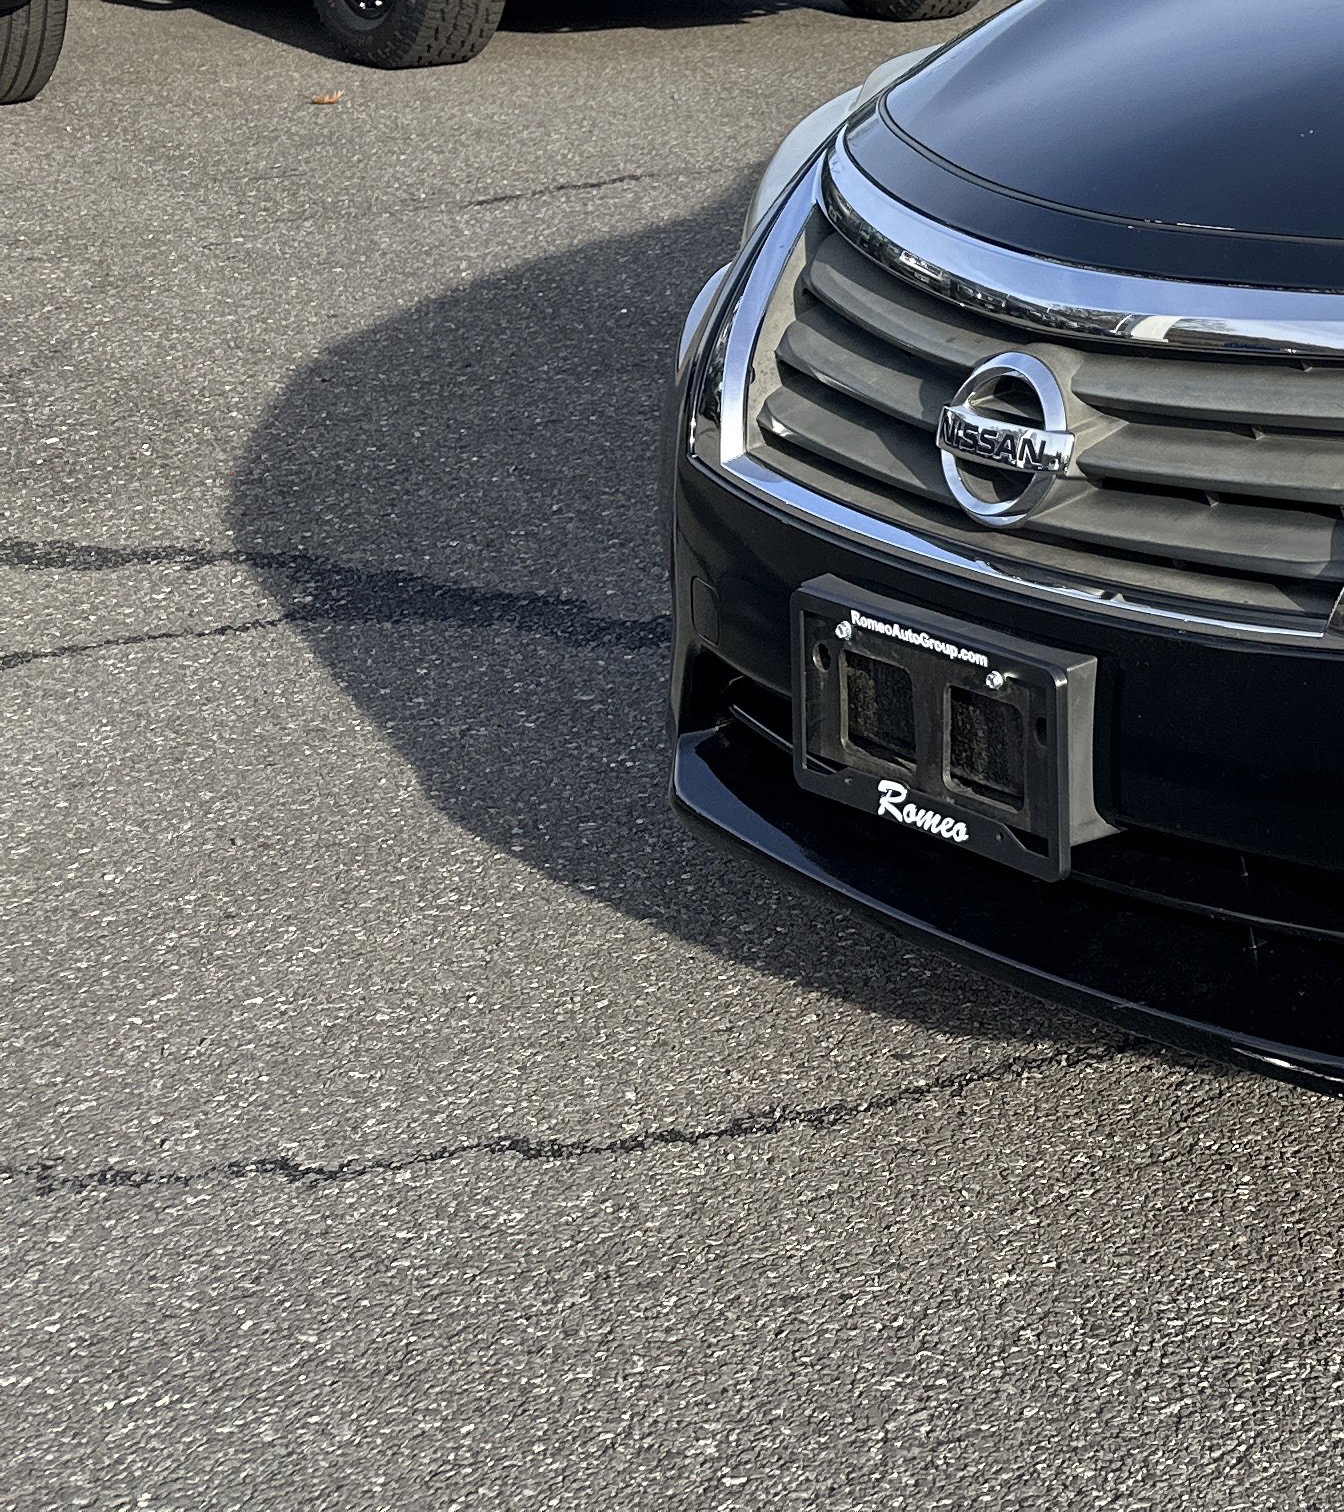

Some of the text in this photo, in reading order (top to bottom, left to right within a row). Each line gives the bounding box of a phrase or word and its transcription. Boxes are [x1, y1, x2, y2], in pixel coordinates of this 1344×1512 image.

[943, 407, 1047, 467] NISSAN
[850, 609, 989, 668] RomeoAutoGroup.com
[877, 779, 970, 843] Romeo
